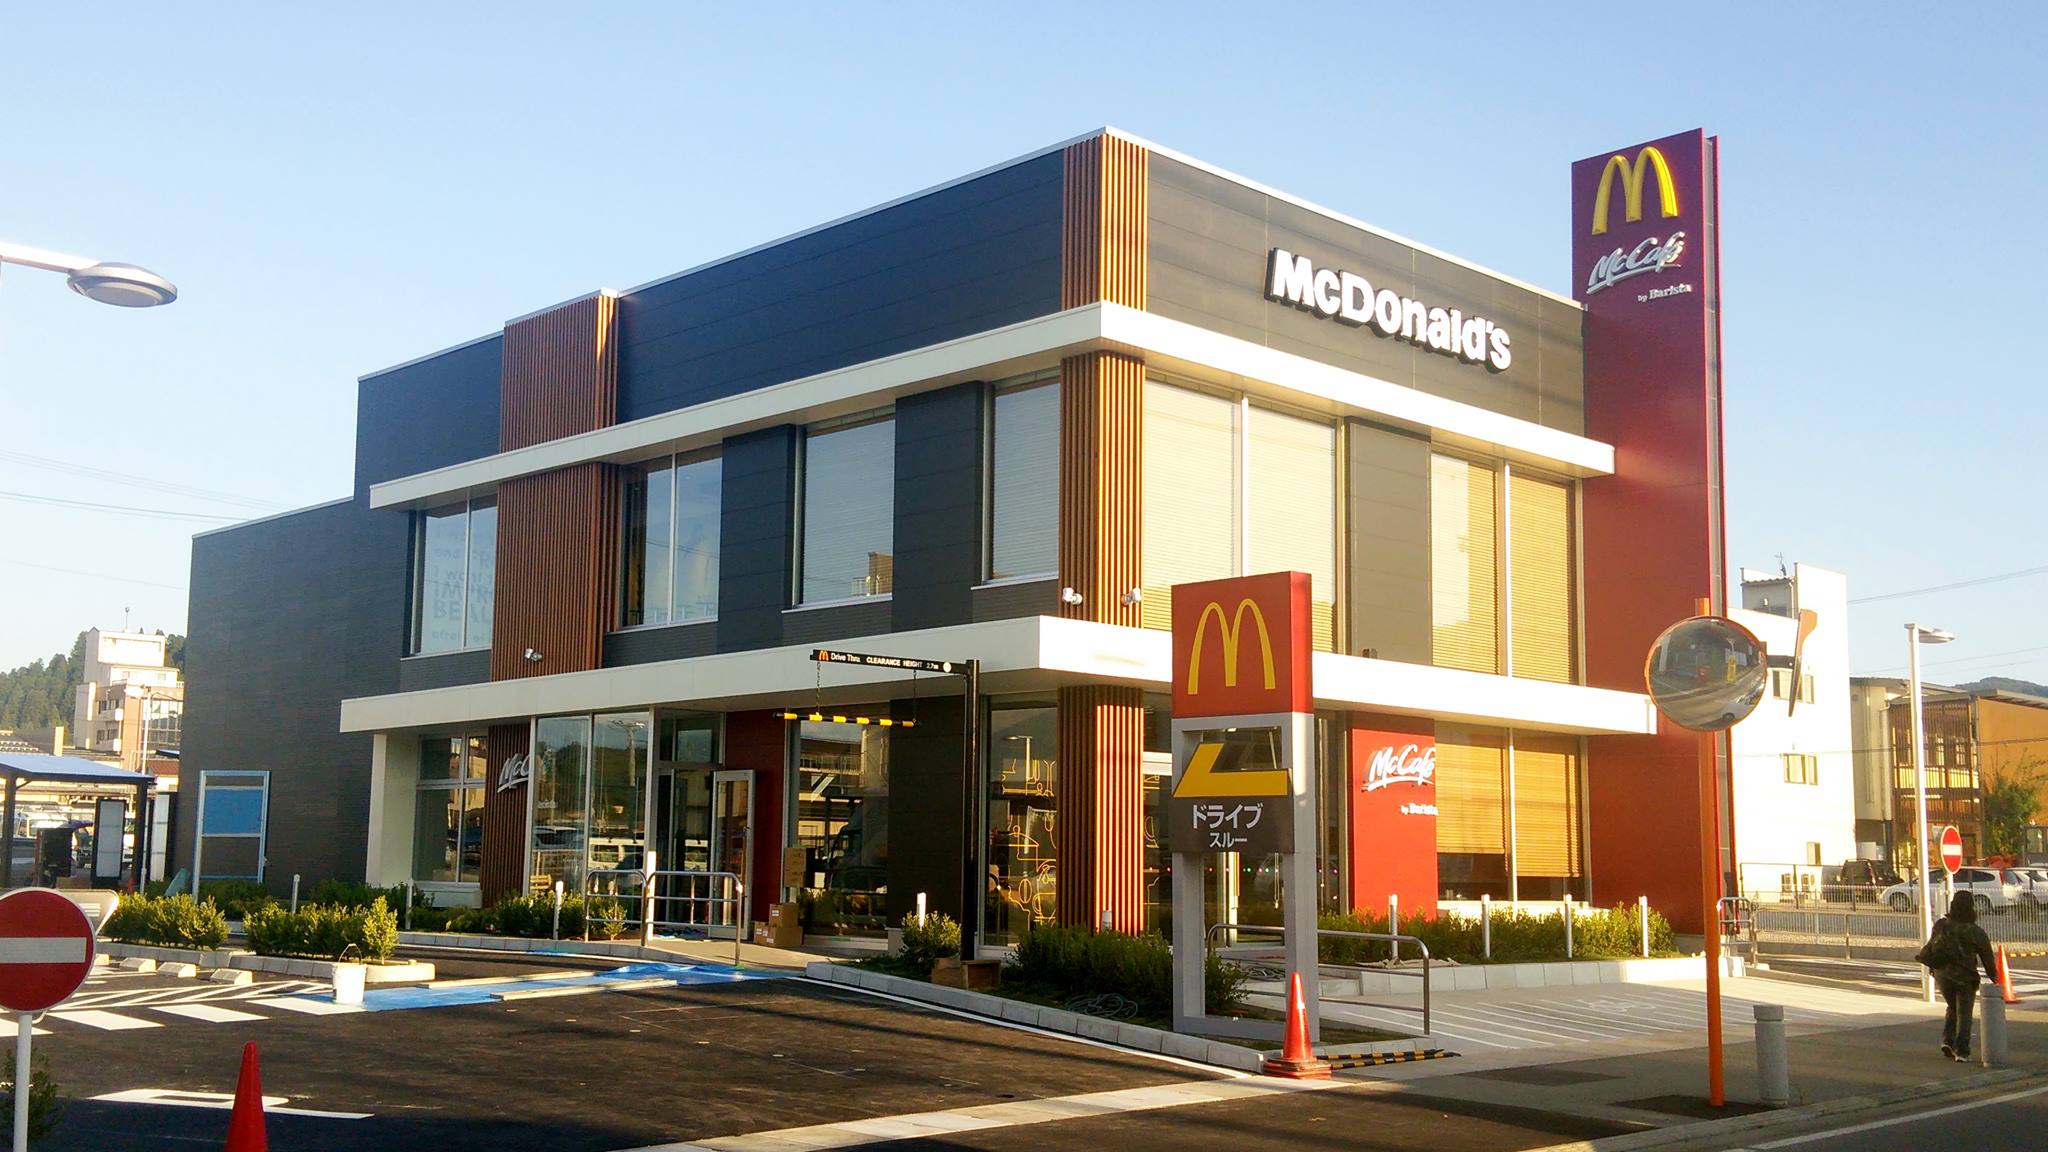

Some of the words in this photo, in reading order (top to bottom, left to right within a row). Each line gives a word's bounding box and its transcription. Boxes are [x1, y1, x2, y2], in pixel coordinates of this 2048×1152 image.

[1637, 293, 1648, 303] by
[1649, 283, 1693, 299] Barista
[1267, 248, 1512, 371] McDonald's
[831, 652, 846, 661] Drive
[847, 654, 860, 663] Thru
[866, 656, 901, 666] CLEARANCE
[903, 660, 923, 668] HEIGHT
[1192, 803, 1264, 829] ドライブ
[1209, 831, 1248, 849] スルー
